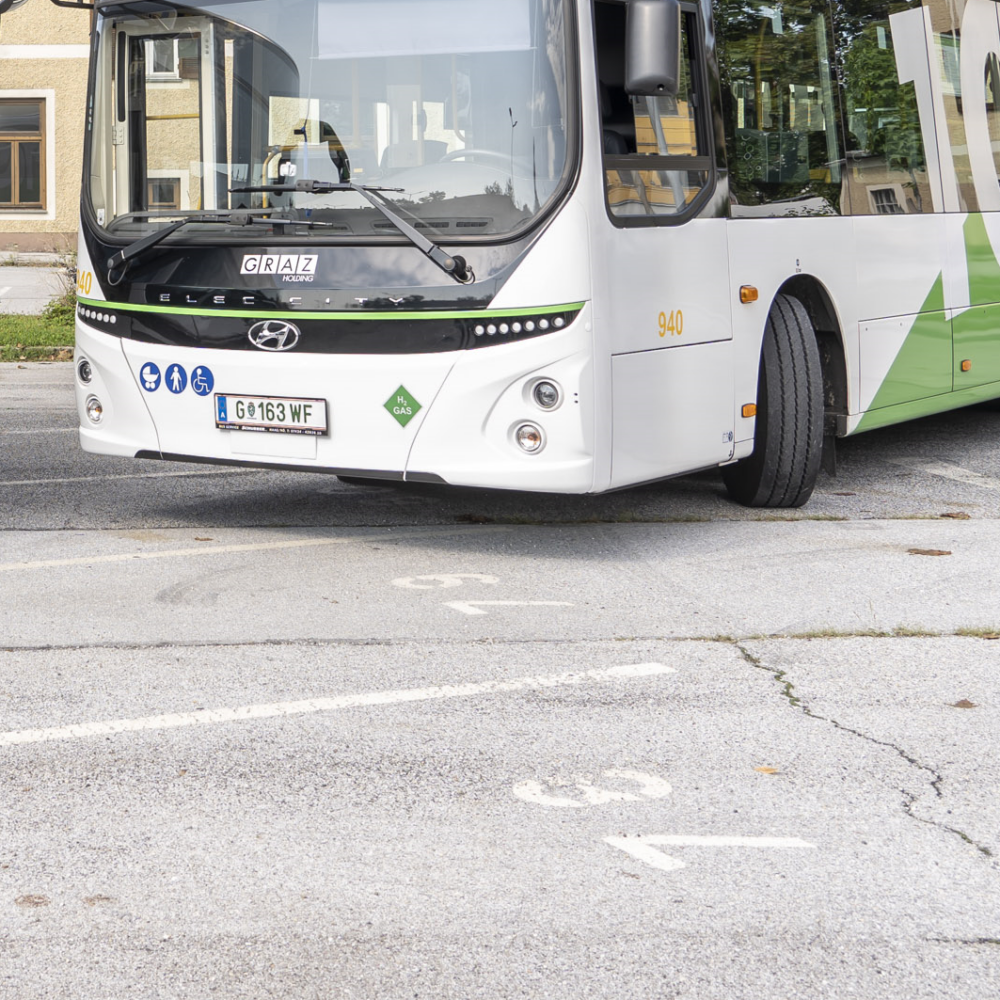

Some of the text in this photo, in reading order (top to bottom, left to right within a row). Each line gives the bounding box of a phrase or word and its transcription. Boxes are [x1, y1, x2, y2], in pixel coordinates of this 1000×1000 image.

[242, 255, 316, 273] GRAZ
[282, 274, 314, 282] HOLDING
[658, 309, 683, 337] 940
[393, 406, 412, 415] GAS
